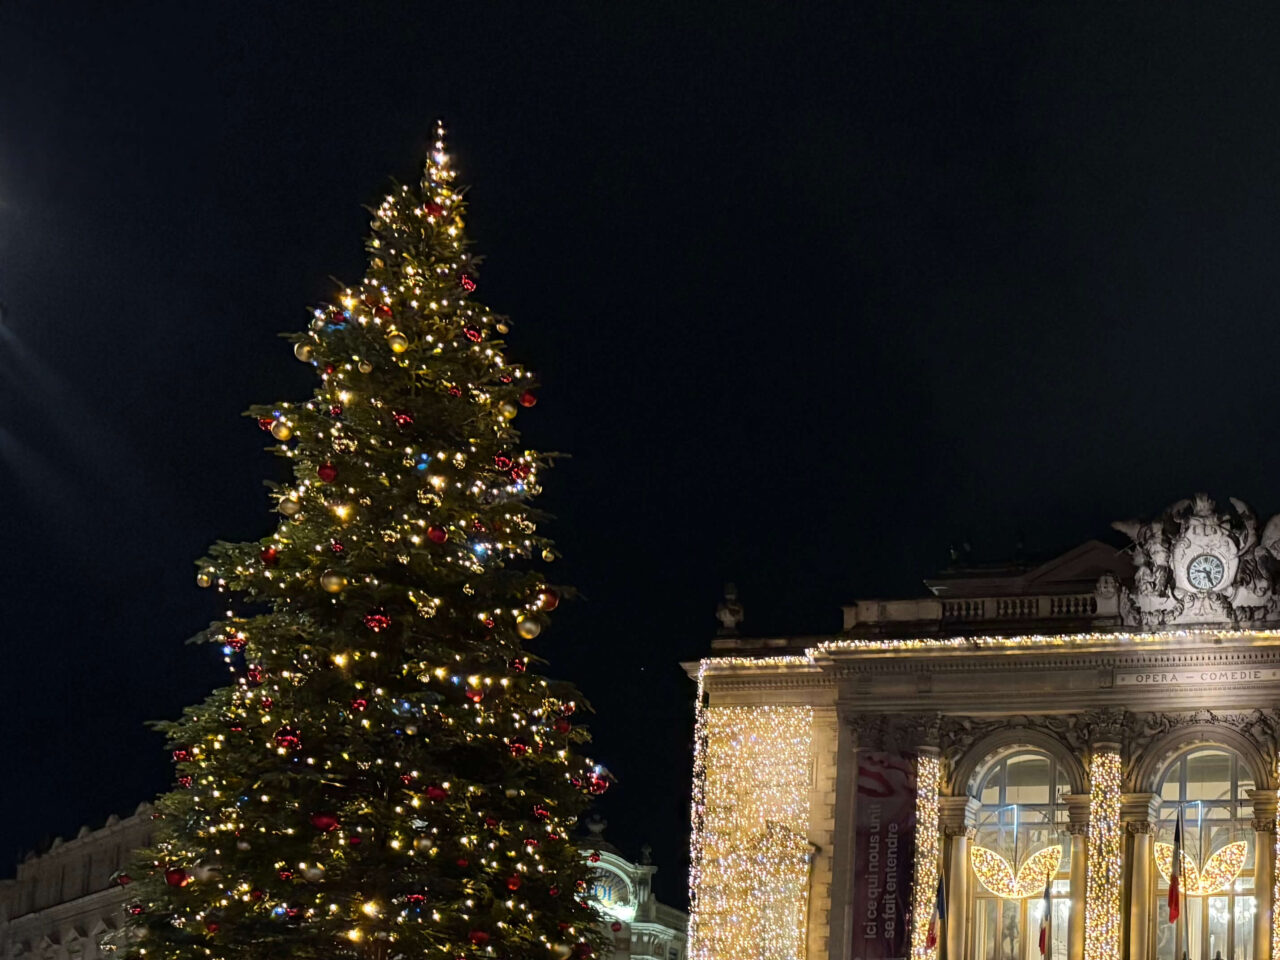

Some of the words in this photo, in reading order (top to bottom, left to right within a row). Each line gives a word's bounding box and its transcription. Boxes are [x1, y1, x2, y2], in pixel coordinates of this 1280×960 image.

[1135, 673, 1179, 684] OPERA
[1200, 670, 1262, 682] COMEDIE
[868, 804, 880, 833] unit
[868, 834, 880, 872] nous
[884, 823, 898, 892] entendre
[864, 874, 882, 898] qui
[867, 901, 878, 919] ce
[882, 893, 896, 919] fait
[863, 921, 877, 939] Ici
[884, 920, 895, 939] se
